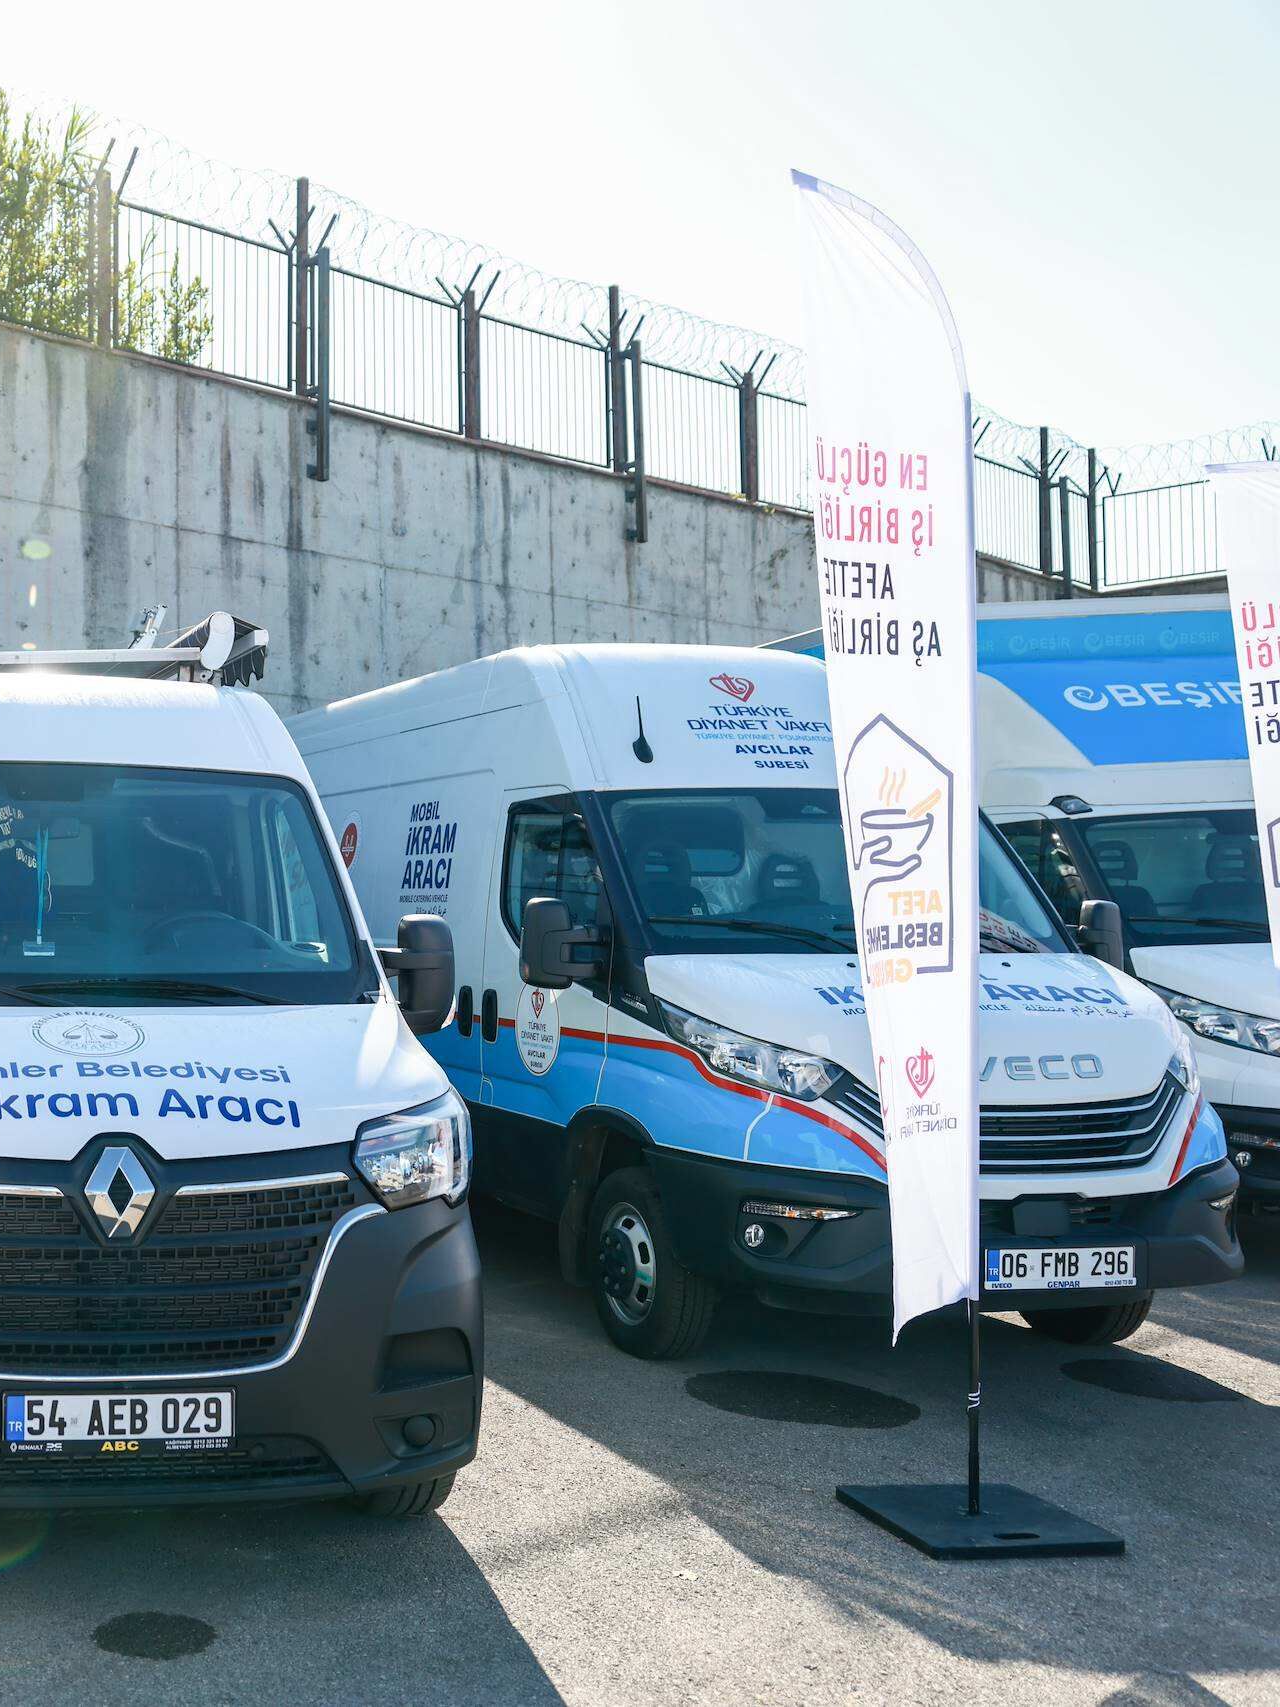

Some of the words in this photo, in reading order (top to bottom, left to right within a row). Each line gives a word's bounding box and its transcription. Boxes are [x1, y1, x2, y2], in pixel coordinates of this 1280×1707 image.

[709, 704, 793, 718] TÜRKİYE
[687, 718, 768, 731] DİYANET
[776, 720, 832, 732] VAKFI
[736, 745, 814, 755] AVCILAR
[401, 858, 453, 890] ARACI
[983, 984, 1128, 1005] ARACI
[78, 1060, 291, 1084] Belediyesi
[158, 1088, 301, 1128] Aracı
[1002, 1253, 1028, 1278] 06
[1041, 1252, 1079, 1277] FMB
[1091, 1251, 1128, 1276] 296
[9, 1421, 22, 1432] TR
[27, 1400, 67, 1436] 54
[86, 1398, 148, 1436] AEB
[161, 1397, 222, 1435] 029
[101, 1441, 139, 1451] ABC
